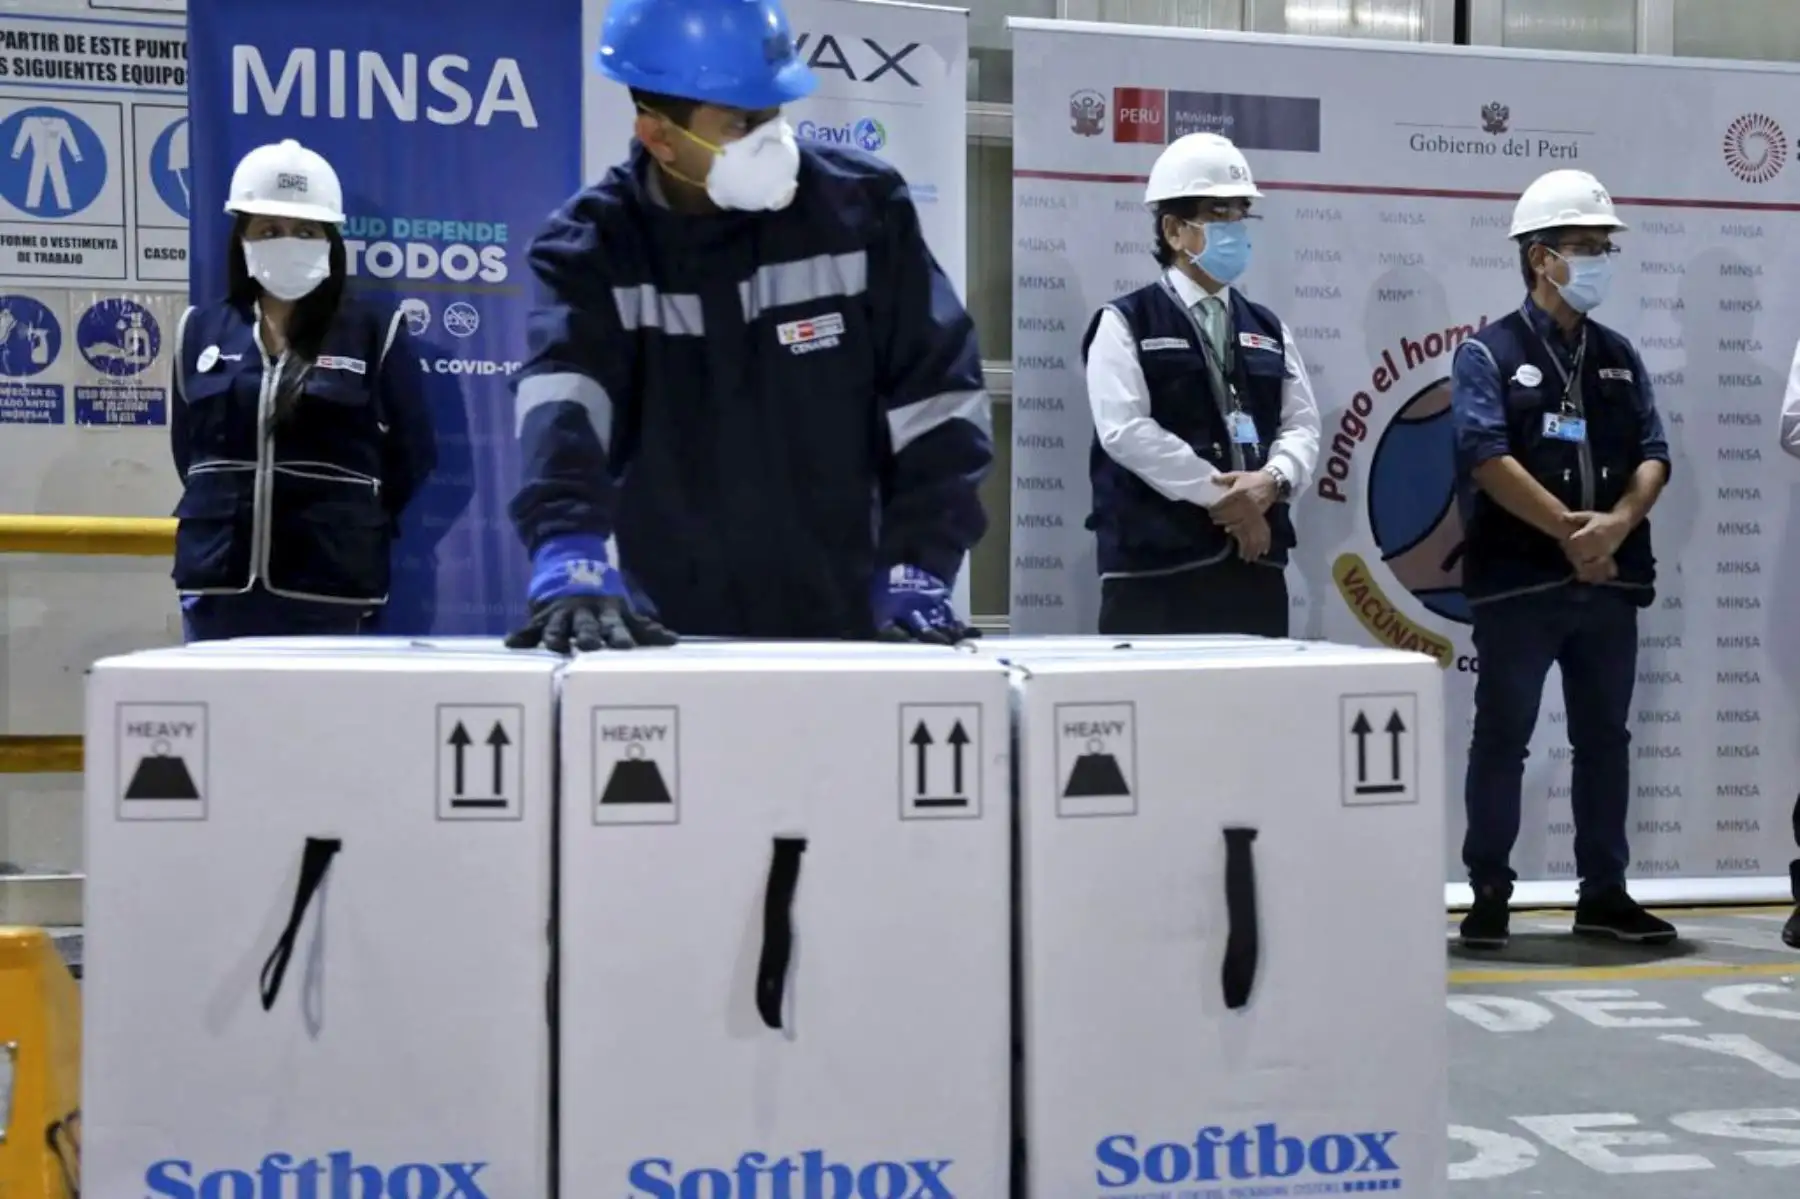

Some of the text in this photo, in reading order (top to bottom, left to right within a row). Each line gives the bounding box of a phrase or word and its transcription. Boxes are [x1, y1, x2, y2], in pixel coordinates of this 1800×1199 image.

[64, 34, 86, 54] DE
[90, 36, 131, 56] ESTE
[13, 57, 117, 82] SIGUIENTES
[121, 63, 188, 86] EQUIPO
[233, 44, 538, 128] MINSA
[1119, 105, 1160, 125] PERÚ
[797, 119, 851, 144] Gavi
[1409, 133, 1579, 160] Gobierno del Perú
[1018, 194, 1066, 209] MINSA
[1295, 208, 1343, 222] MINSA
[1379, 211, 1426, 226] MINSA
[393, 217, 508, 243] DEPENDE
[1641, 221, 1686, 235] MINSA
[1720, 224, 1764, 239] MINSA
[40, 236, 48, 247] O
[50, 237, 118, 250] VESTIMENTA
[1018, 237, 1066, 252] MINSA
[17, 251, 83, 264] DE TRABAJO
[143, 247, 187, 261] CASCO
[1295, 249, 1342, 263] MINSA
[1378, 252, 1425, 266] MINSA
[343, 240, 508, 283] TODOS
[1470, 255, 1515, 270] MINSA
[1641, 261, 1686, 275] MINSA
[1720, 263, 1764, 277] MINSA
[1018, 275, 1066, 291] MINSA
[1295, 286, 1342, 300] MINSA
[1640, 297, 1685, 311] MINSA
[1719, 300, 1763, 313] MINSA
[1018, 317, 1065, 332] MINSA
[1294, 326, 1341, 340] MINSA
[1640, 336, 1684, 350] MINSA
[1719, 339, 1763, 352] MINSA
[1018, 356, 1065, 371] MINSA
[1650, 372, 1684, 386] INSA
[1718, 375, 1763, 388] MINSA
[1018, 396, 1065, 411] MINSA
[1718, 412, 1762, 426] MINSA
[1318, 391, 1373, 504] Pongo
[1371, 349, 1401, 393] el
[1017, 434, 1065, 449] MINSA
[1718, 448, 1762, 462] MINSA
[1017, 476, 1064, 491] MINSA
[1718, 487, 1762, 501] MINSA
[1017, 514, 1064, 529] MINSA
[1717, 522, 1761, 536] MINSA
[1016, 556, 1064, 571] MINSA
[1717, 561, 1761, 575] MINSA
[1016, 593, 1064, 608] MINSA
[1717, 597, 1761, 610] MINSA
[1640, 636, 1682, 649] MINSA
[1717, 636, 1761, 650] MINSA
[1638, 671, 1682, 684] MINSA
[1717, 671, 1761, 684] MINSA
[1637, 711, 1682, 724] MINSA
[1717, 710, 1761, 724] MINSA
[126, 721, 198, 740] HEAVY
[602, 725, 668, 743] HEAVY
[1064, 720, 1126, 738] HEAVY
[1637, 746, 1682, 760] MINSA
[1717, 745, 1761, 759] MINSA
[1637, 785, 1682, 799] MINSA
[1716, 784, 1761, 798] MINSA
[1636, 820, 1682, 834] MINSA
[1716, 819, 1760, 833] MINSA
[1636, 859, 1680, 873] MINSA
[1716, 858, 1760, 873] MINSA
[1095, 1122, 1400, 1188] Softbox
[145, 1149, 492, 1199] Softbox
[628, 1149, 955, 1199] Softbox
